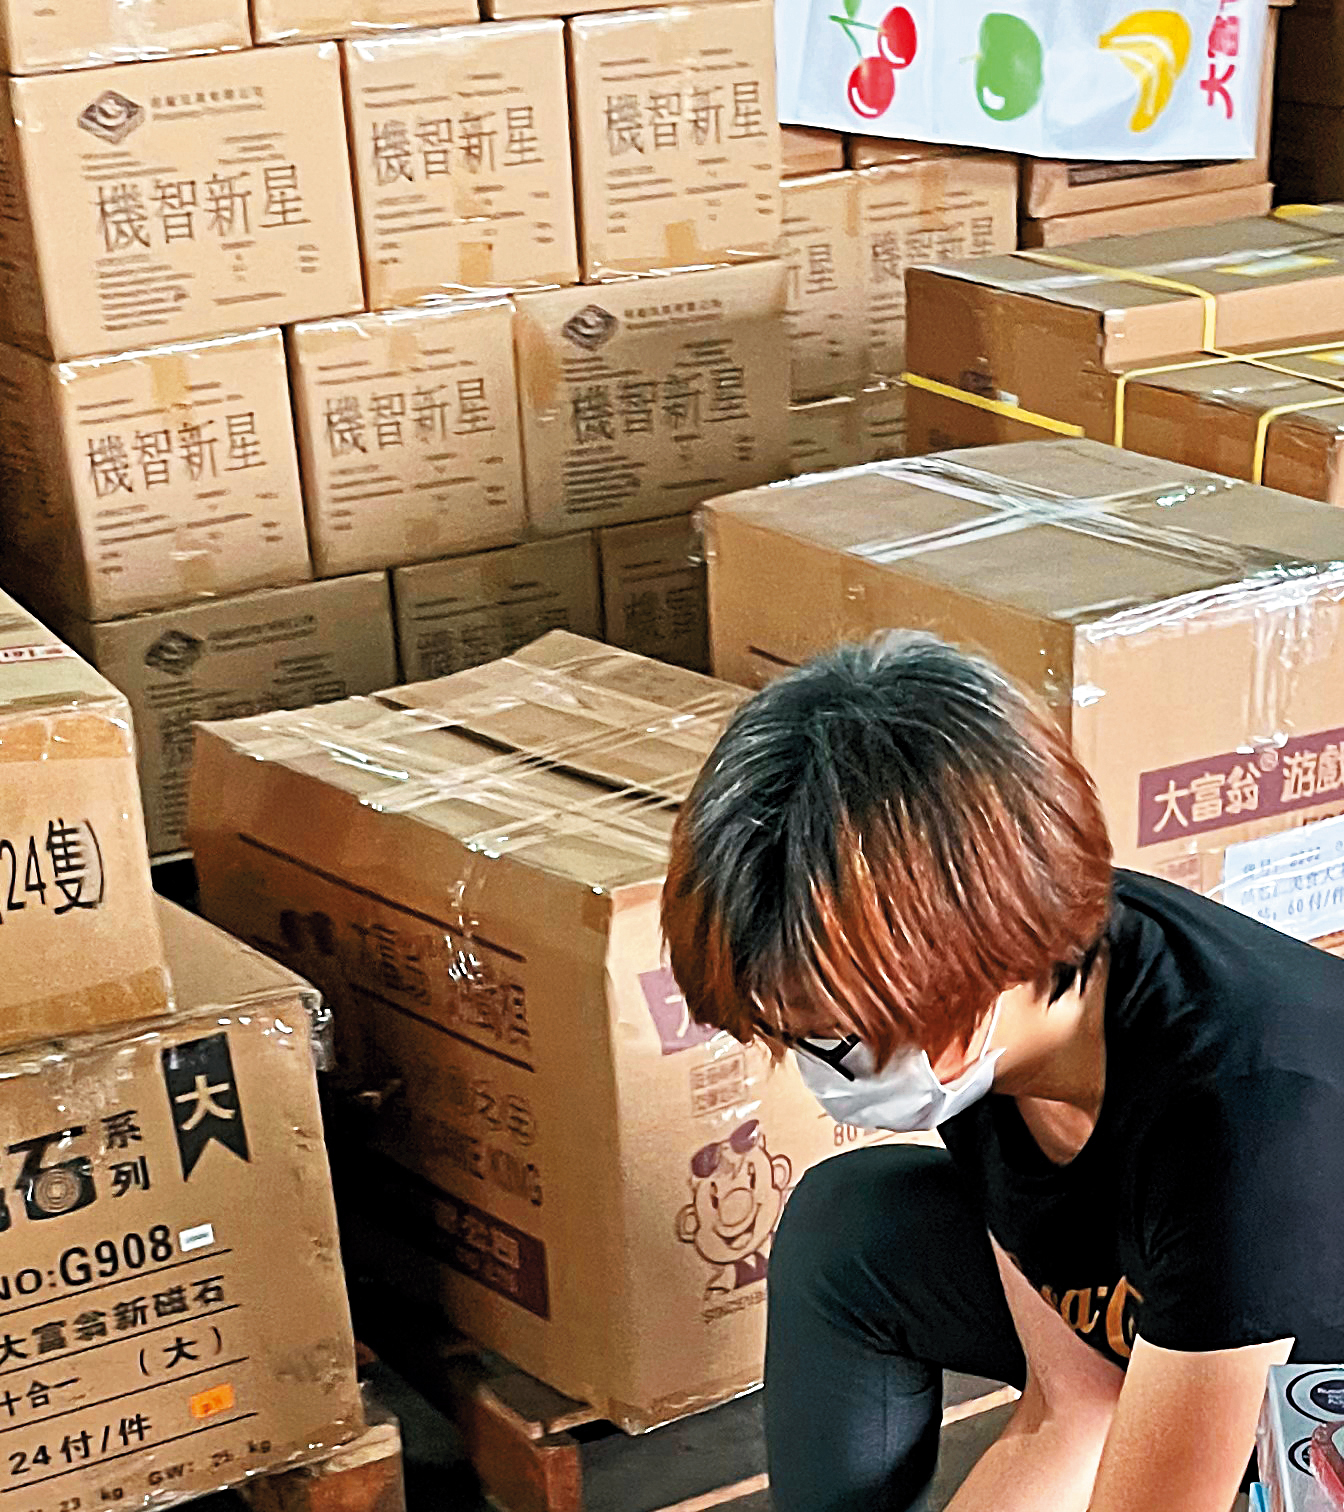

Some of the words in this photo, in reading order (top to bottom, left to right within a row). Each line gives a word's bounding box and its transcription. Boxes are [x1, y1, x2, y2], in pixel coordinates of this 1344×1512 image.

[370, 105, 544, 187] 機智新星
[604, 80, 768, 157] 機智新星
[94, 163, 312, 253] 機智新星
[323, 377, 497, 457] 機智新星
[572, 367, 752, 445] 機智新星
[87, 410, 268, 499] 機智新星
[1153, 762, 1262, 833] 大富翁
[176, 1073, 236, 1132] 大
[100, 1109, 152, 1200] 系列
